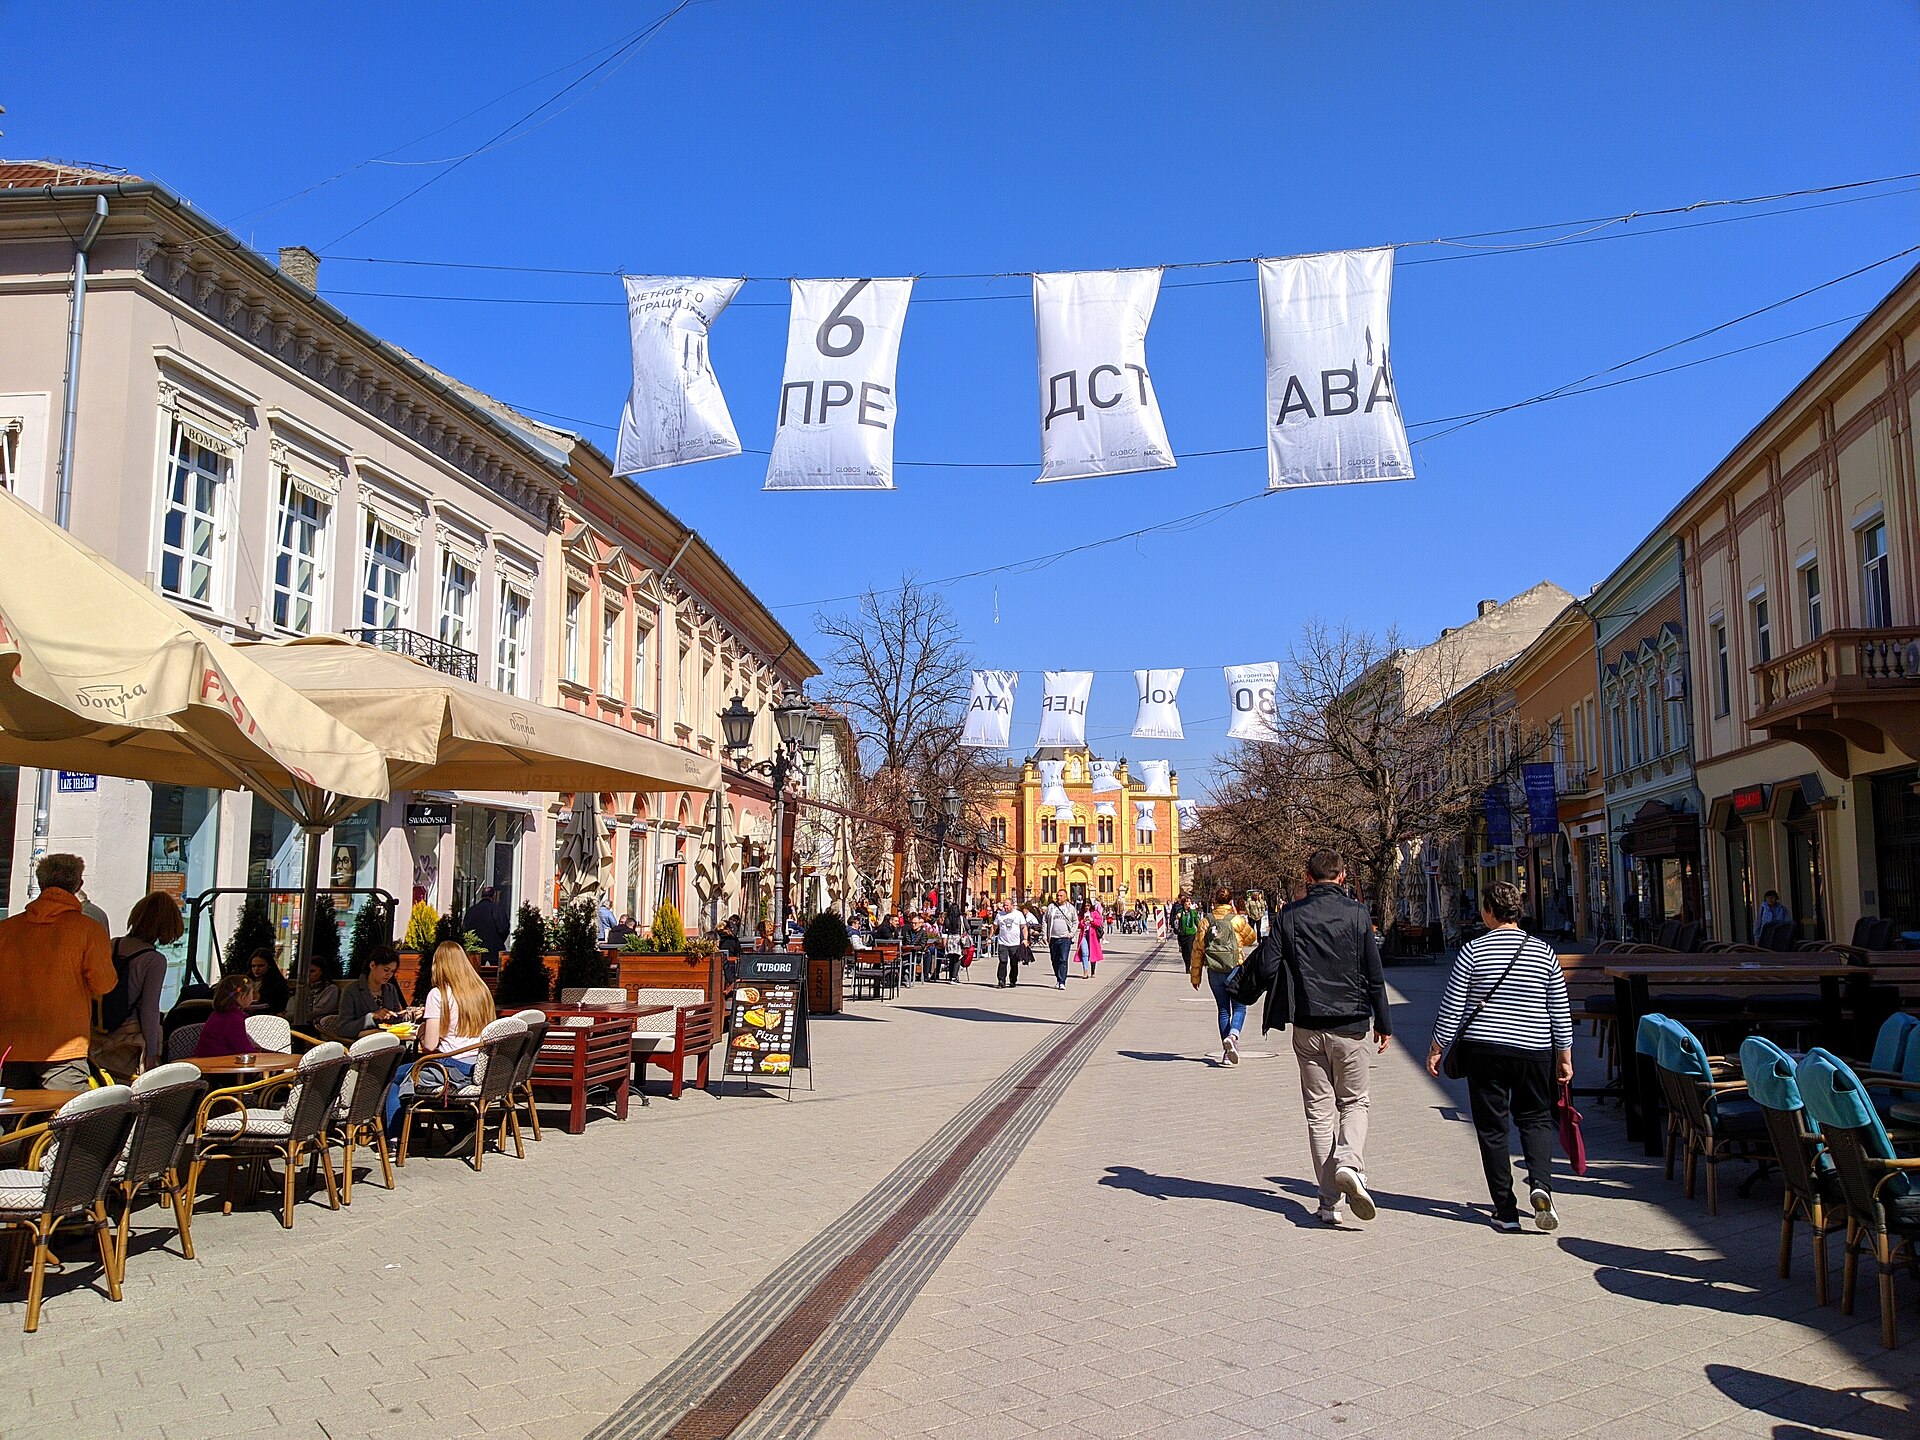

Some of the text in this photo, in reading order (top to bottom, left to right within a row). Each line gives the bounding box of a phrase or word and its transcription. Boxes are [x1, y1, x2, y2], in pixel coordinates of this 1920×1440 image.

[629, 286, 692, 305] МЕТНОСТ
[816, 279, 870, 357] 6
[779, 380, 891, 430] ПРЕ
[1044, 362, 1150, 431] ДСТ
[1275, 365, 1398, 426] АВА
[188, 428, 229, 455] BOMAR
[1109, 448, 1138, 457] GLOBOS
[1347, 458, 1376, 466] GLOBOS
[296, 481, 329, 503] BOMAR
[384, 524, 412, 543] BOMAR
[75, 683, 148, 709] Donna
[61, 779, 72, 790] LAZE
[408, 816, 447, 824] SWAROVSKI
[756, 962, 792, 973] TUBORG
[755, 1029, 779, 1041] Pizza
